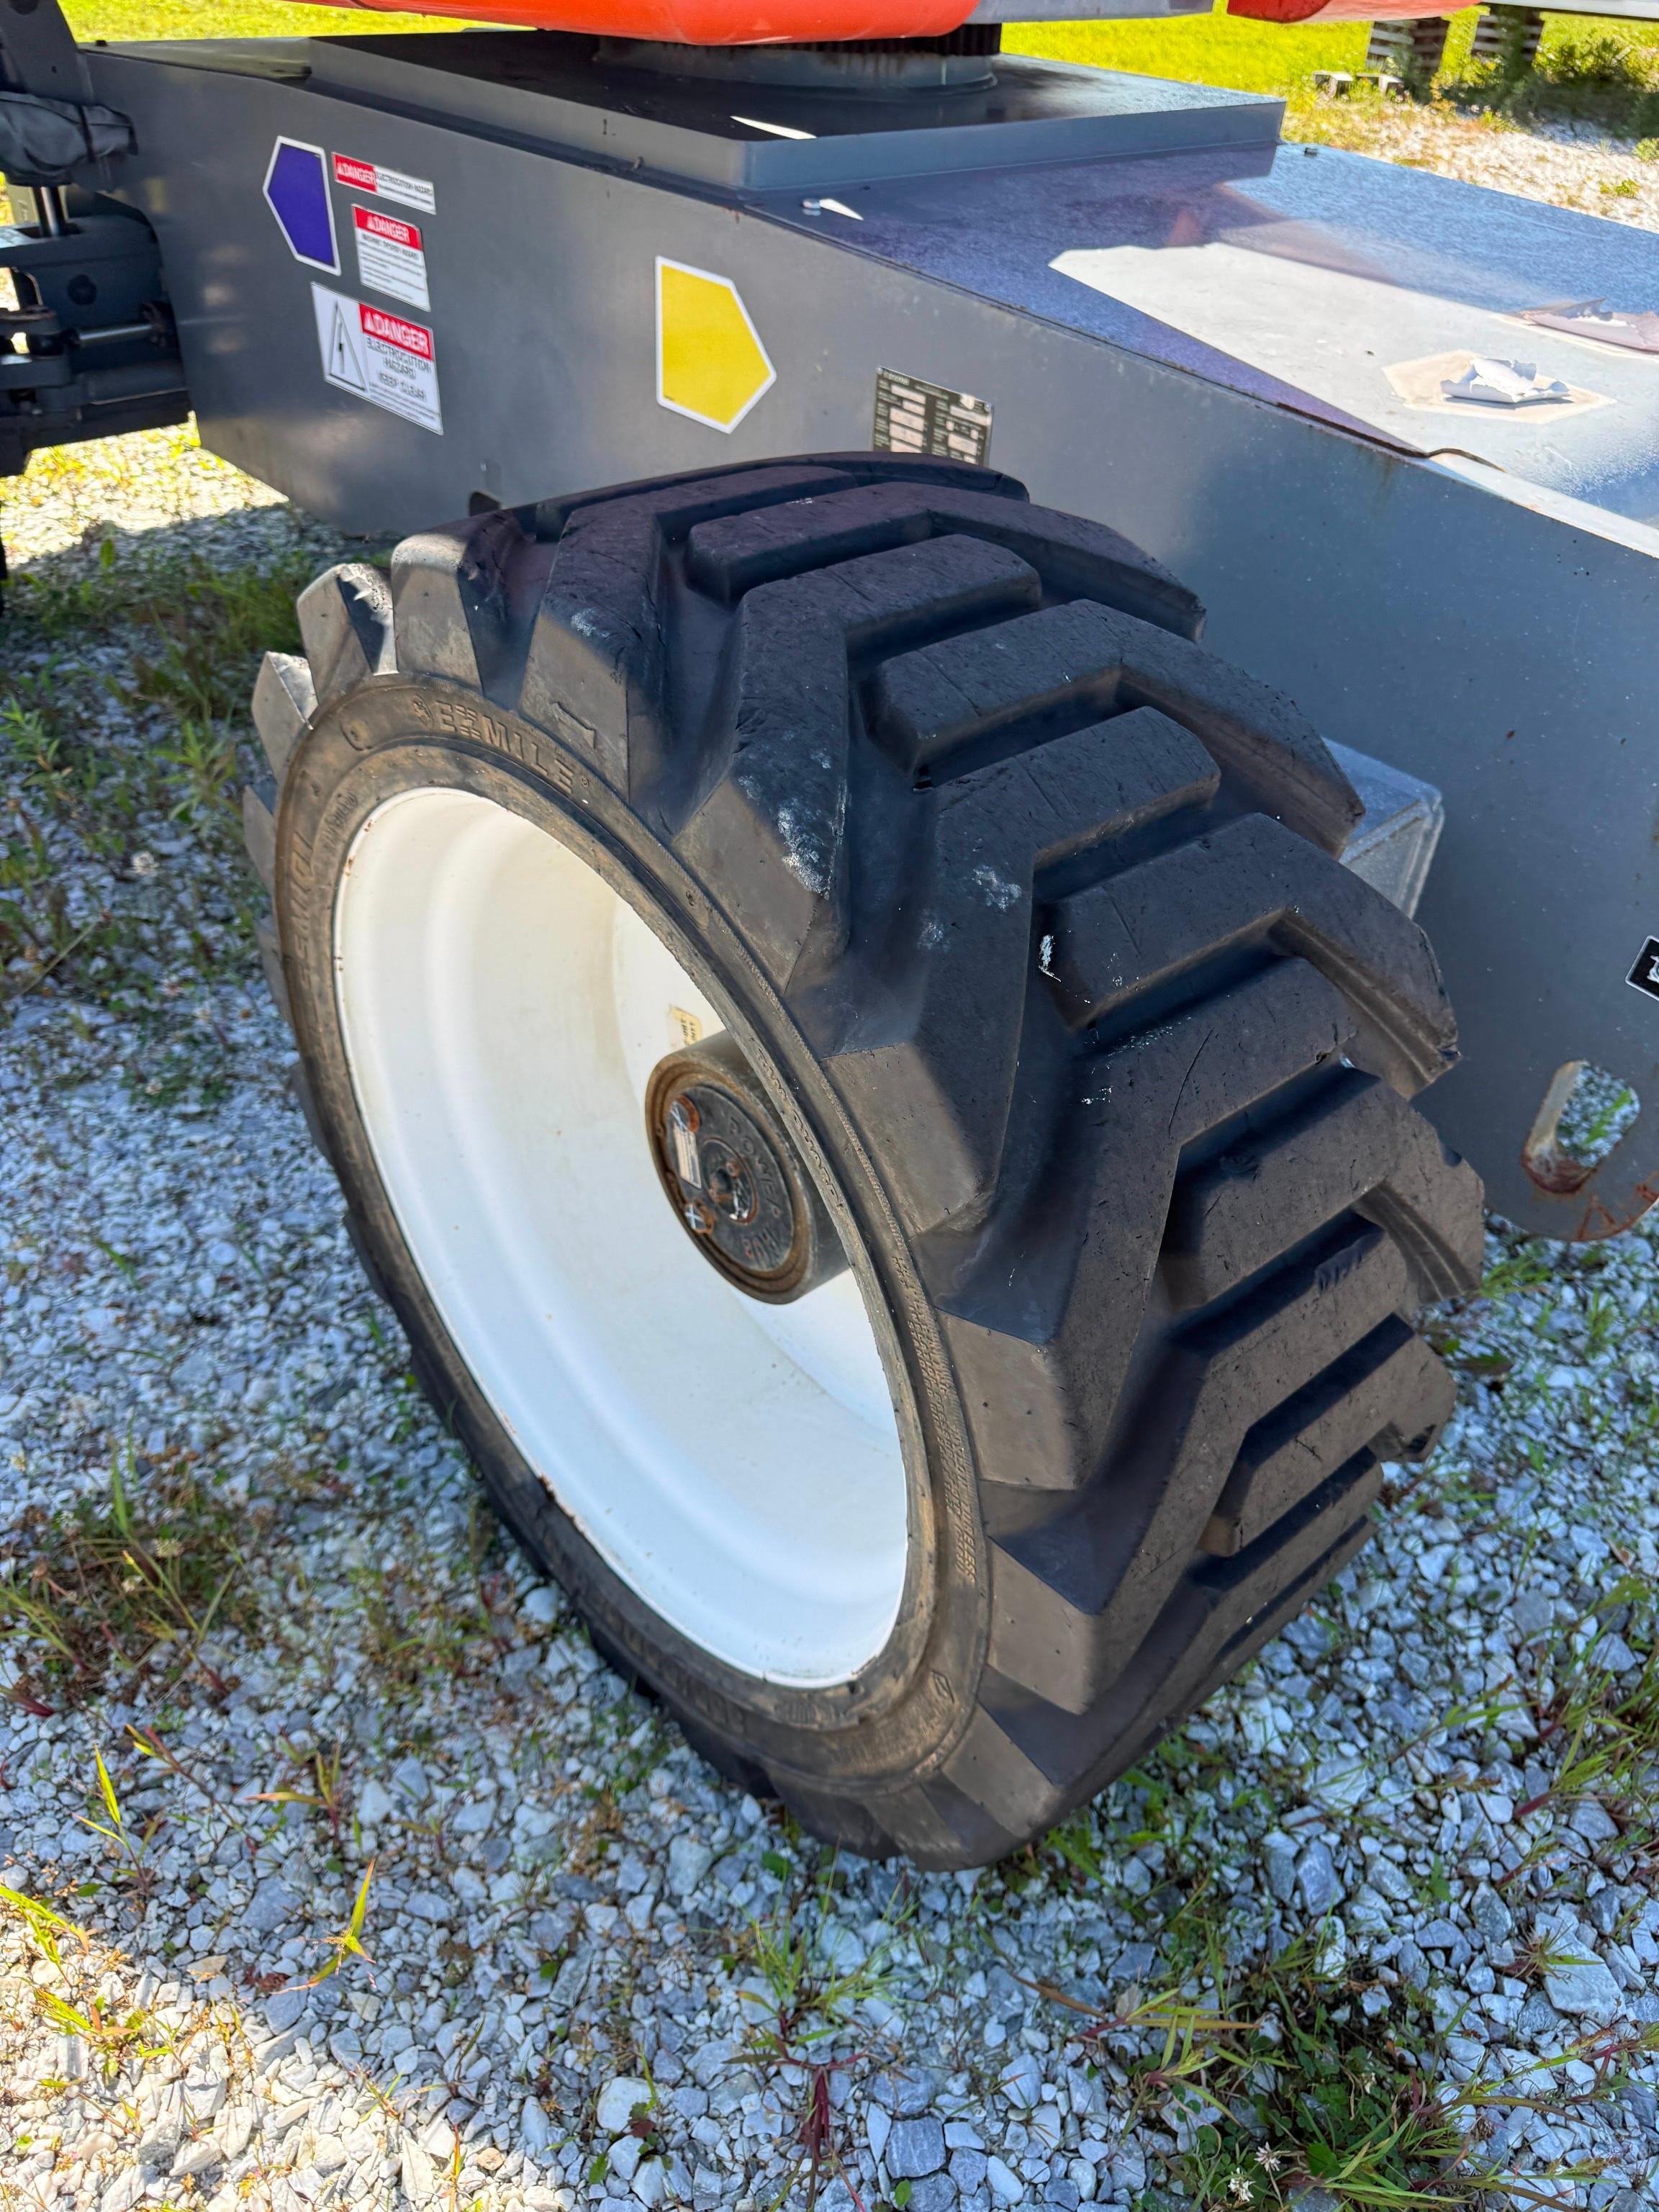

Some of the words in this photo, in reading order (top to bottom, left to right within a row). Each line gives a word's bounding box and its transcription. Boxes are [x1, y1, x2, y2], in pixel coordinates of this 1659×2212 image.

[340, 163, 376, 186] DANGER
[373, 217, 410, 245] DANGER
[372, 314, 430, 353] DANGER
[367, 337, 432, 374] ELECTROCUTION
[384, 358, 416, 380] HAZARD
